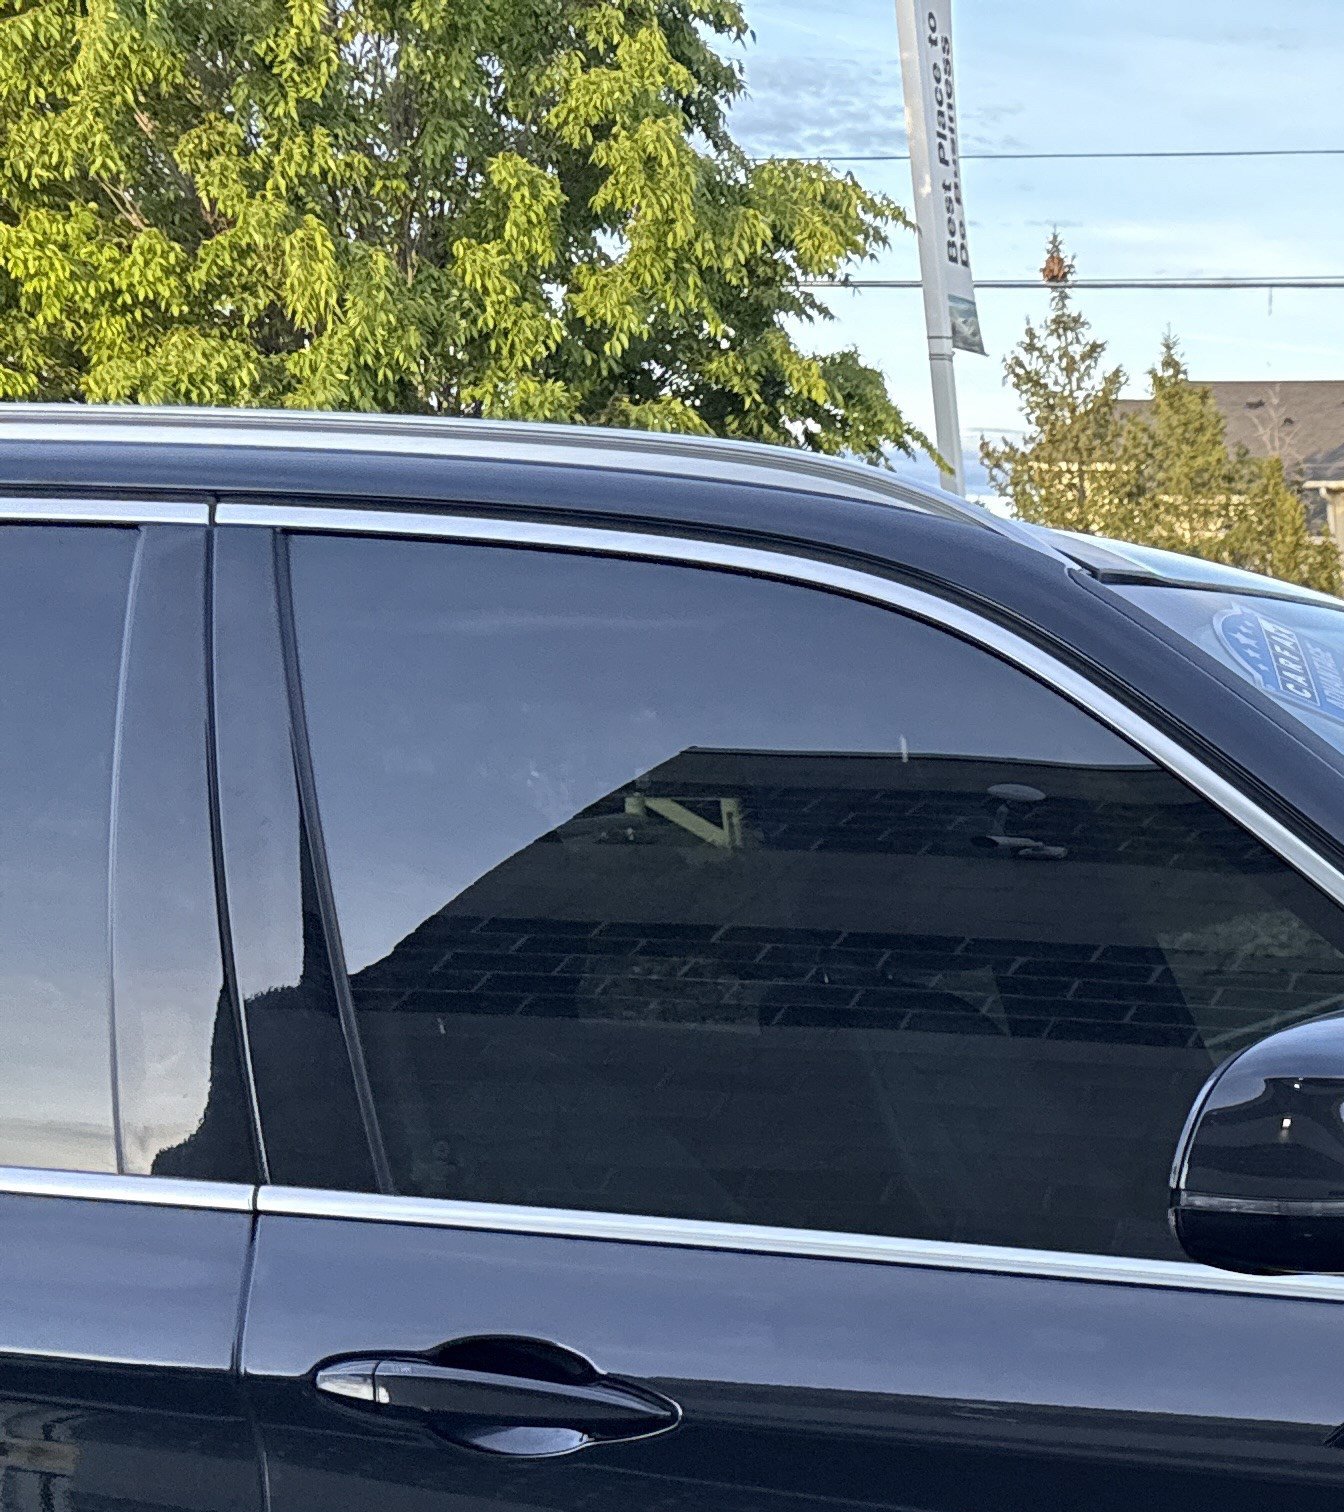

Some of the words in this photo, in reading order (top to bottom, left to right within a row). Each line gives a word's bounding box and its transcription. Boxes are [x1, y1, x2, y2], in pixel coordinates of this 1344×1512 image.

[928, 11, 939, 48] to
[932, 62, 950, 167] Place
[942, 179, 958, 264] Best
[1261, 620, 1312, 699] CARFAX
